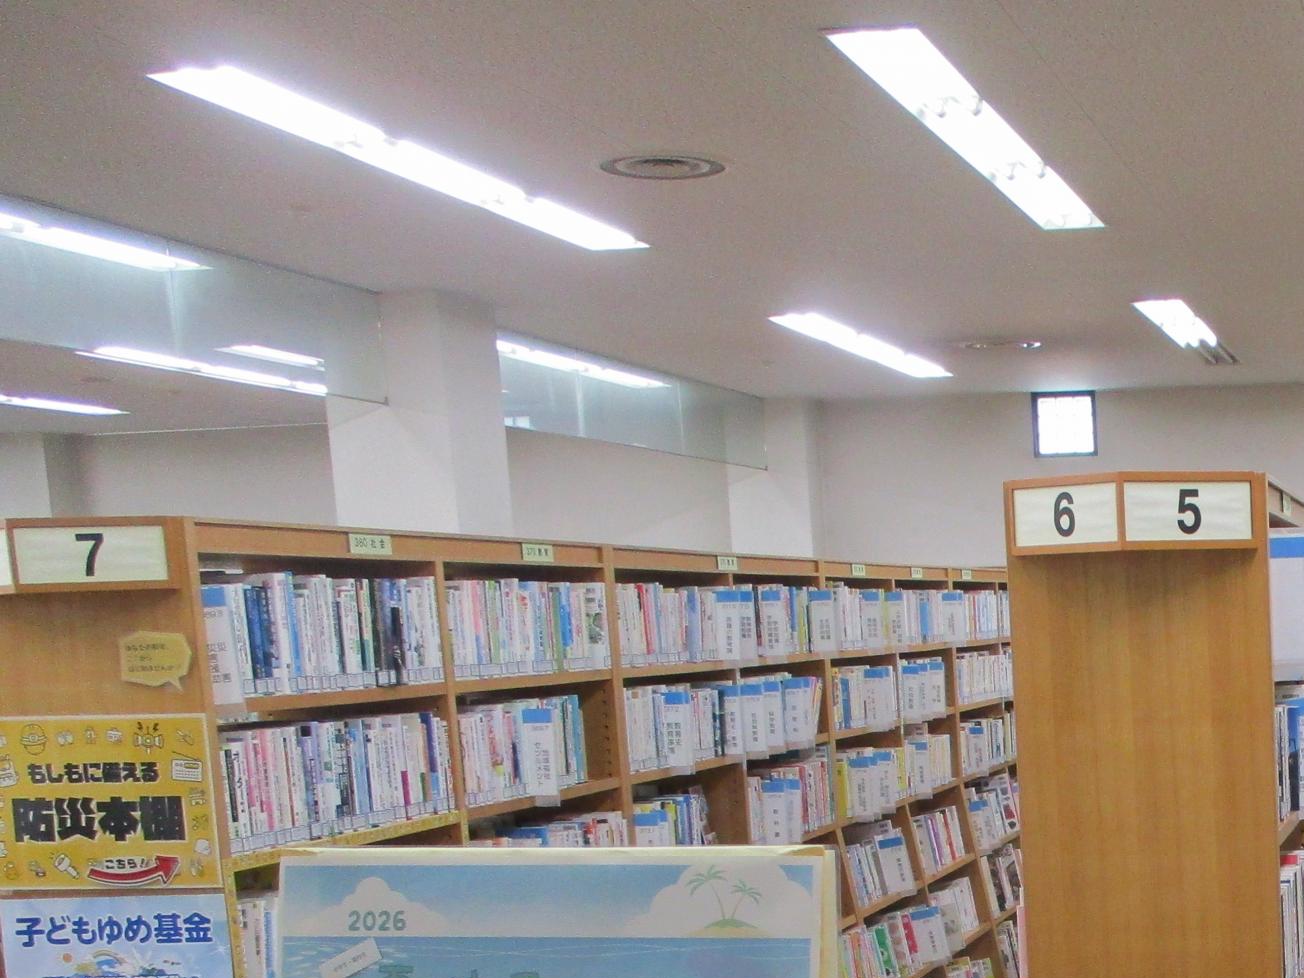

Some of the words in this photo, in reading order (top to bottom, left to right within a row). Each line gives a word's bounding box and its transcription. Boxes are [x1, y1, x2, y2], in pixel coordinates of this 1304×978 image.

[1053, 492, 1076, 537] 6
[1177, 489, 1202, 534] 5
[74, 533, 104, 577] 7
[27, 762, 160, 784] もしもに備える
[12, 796, 187, 843] 防災本棚
[15, 912, 214, 947] 子どもゆめ基金
[348, 909, 407, 932] 2026
